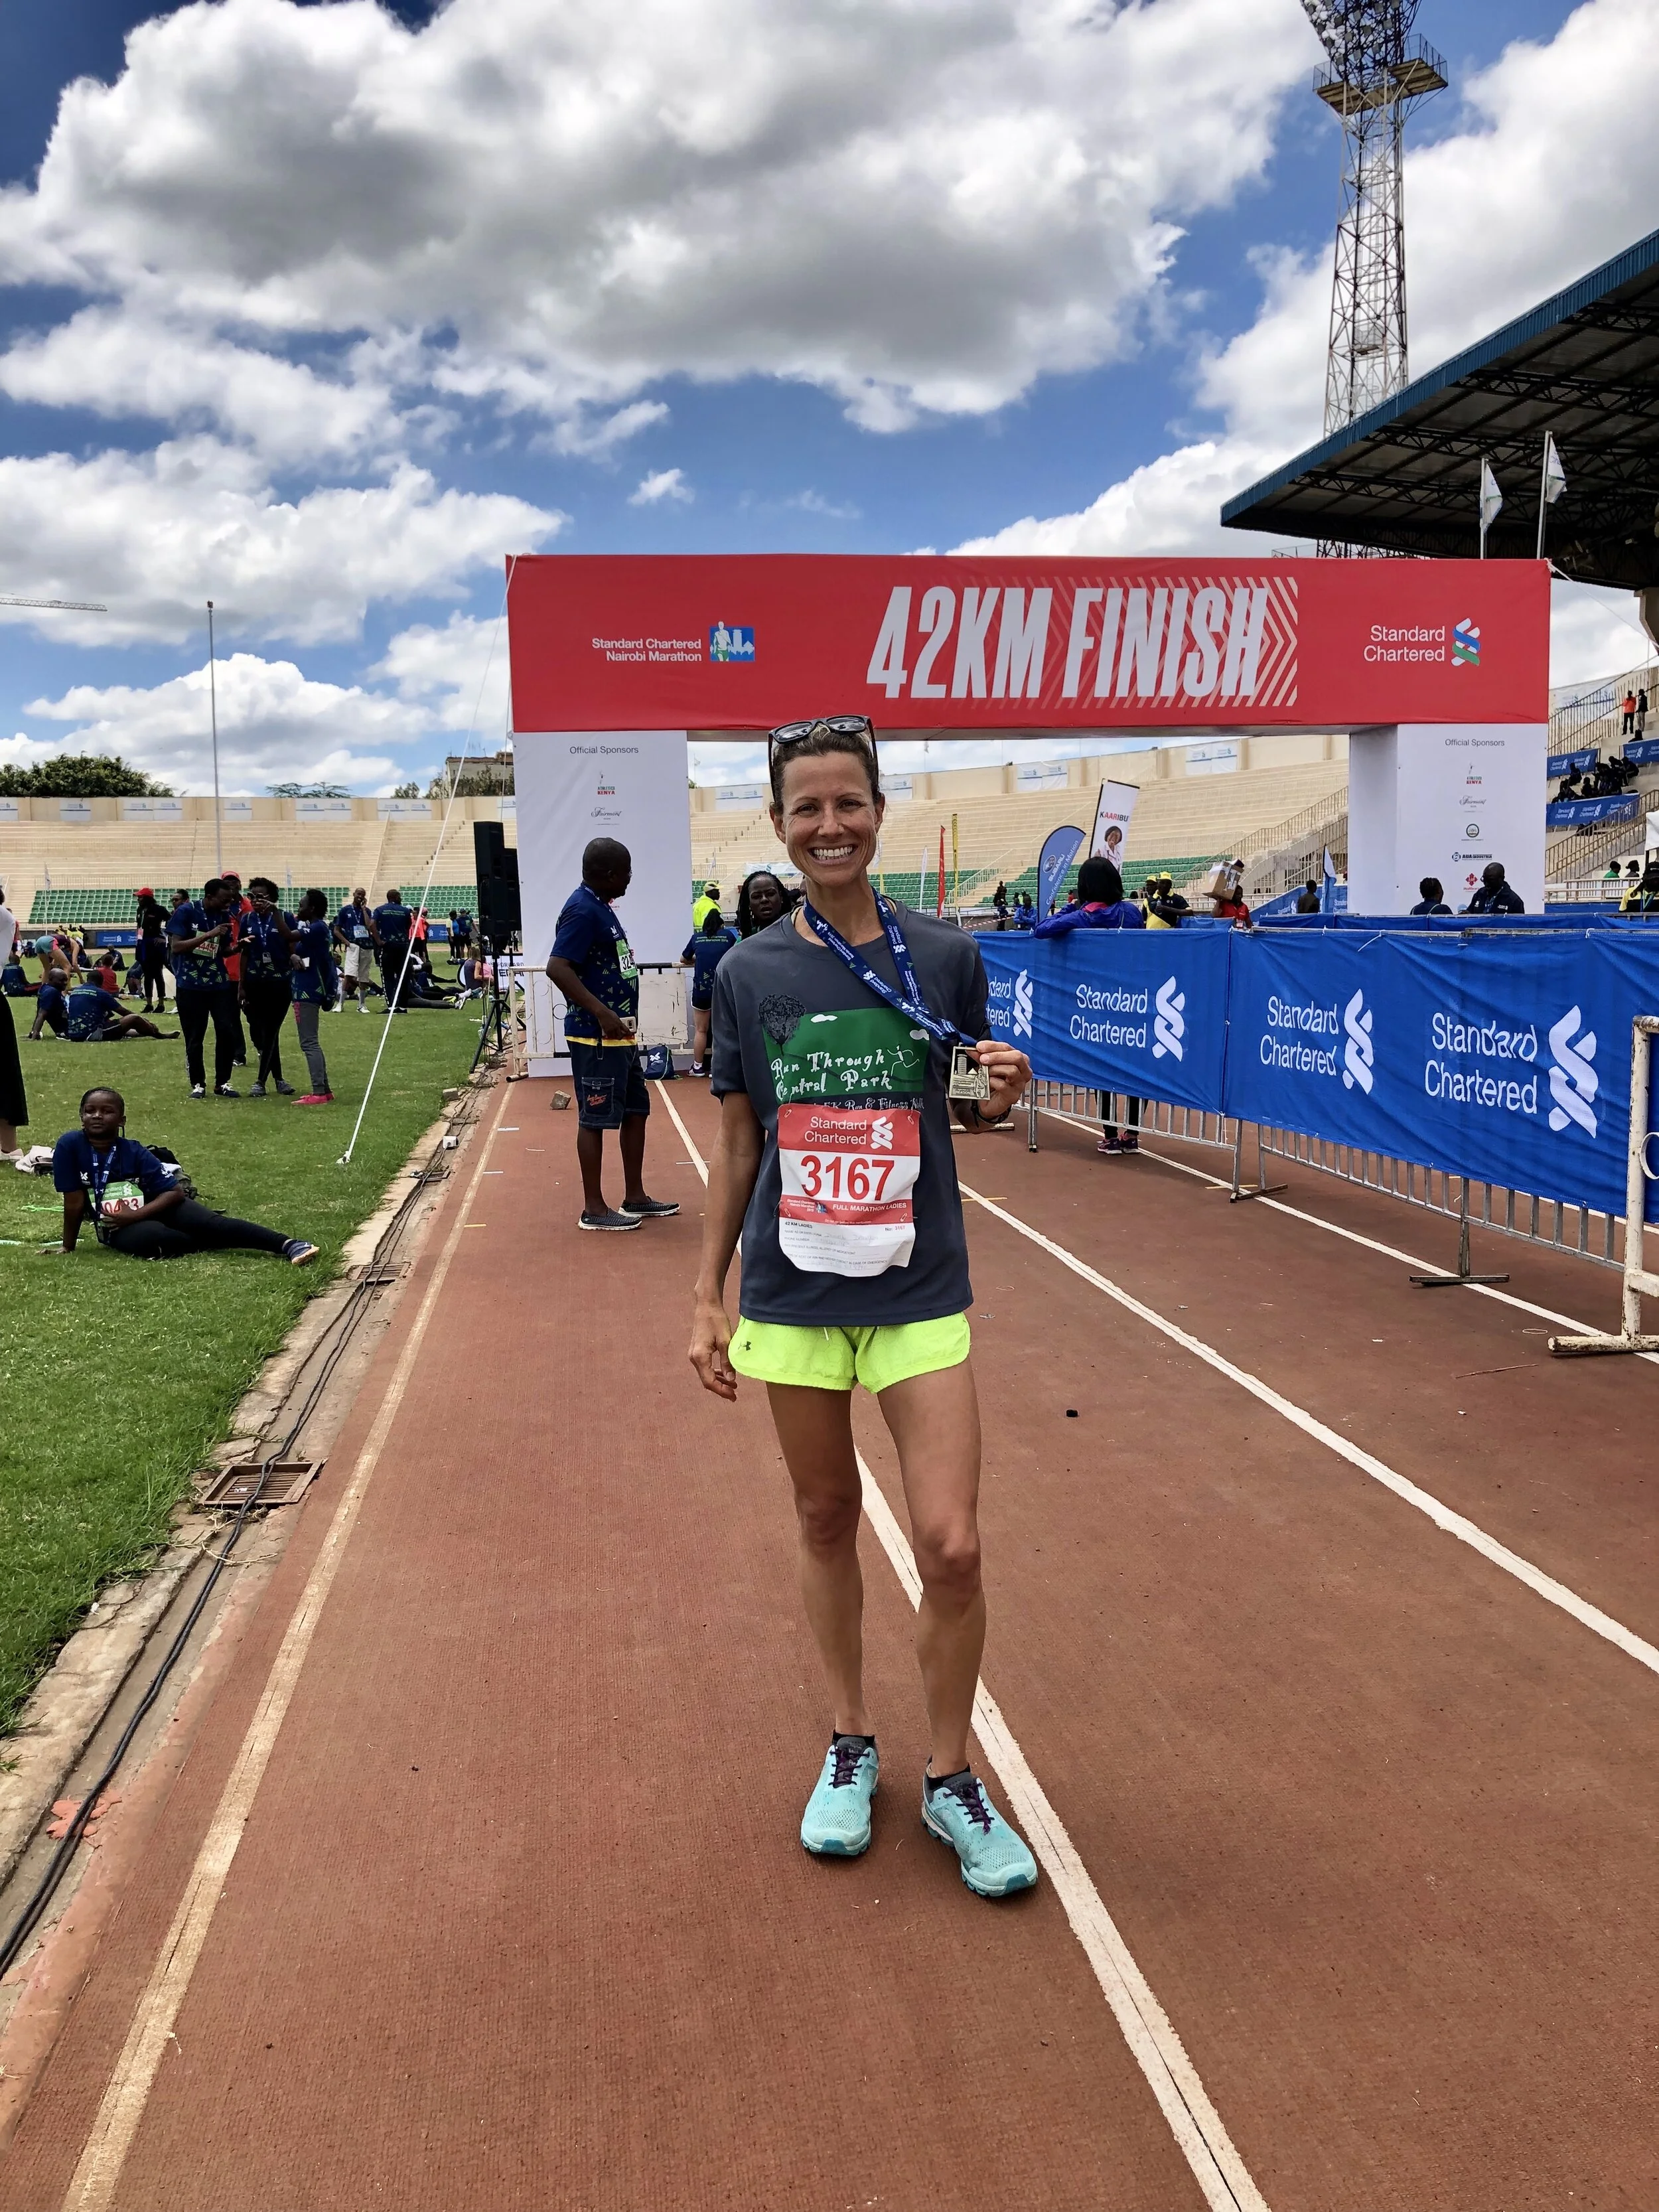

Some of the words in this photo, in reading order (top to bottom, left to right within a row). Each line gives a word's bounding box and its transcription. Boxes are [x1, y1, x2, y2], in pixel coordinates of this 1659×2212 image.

[592, 638, 642, 649] Standard
[646, 638, 701, 649] Chartered
[867, 586, 1052, 698] 42KM
[1062, 587, 1268, 698] FINISH
[1370, 625, 1445, 642] Standard
[606, 651, 646, 662] Nairobi
[649, 652, 702, 662] Marathon
[1364, 644, 1445, 662] Chartered
[600, 746, 639, 755] Sponsors
[1471, 739, 1505, 747] Sponsors
[1100, 811, 1129, 822] KAARIBU
[1066, 840, 1079, 862] Motion
[1048, 853, 1065, 882] SUBARU
[988, 976, 1011, 999] dard
[1076, 984, 1148, 1014] Standard
[986, 1005, 1010, 1028] tered
[1267, 995, 1339, 1035] Standard
[1069, 1015, 1146, 1049] Chartered
[1431, 1012, 1538, 1063] Standard
[770, 1058, 800, 1080] Run
[807, 1049, 885, 1072] Through
[1261, 1034, 1336, 1076] Chartered
[776, 1072, 827, 1102] Central
[840, 1069, 893, 1091] Park
[1425, 1060, 1538, 1114] Chartered
[845, 1099, 863, 1110] Run
[865, 1097, 875, 1110] &
[810, 1116, 867, 1130] Standard
[804, 1130, 867, 1145] Chartered
[800, 1155, 895, 1201] 3167
